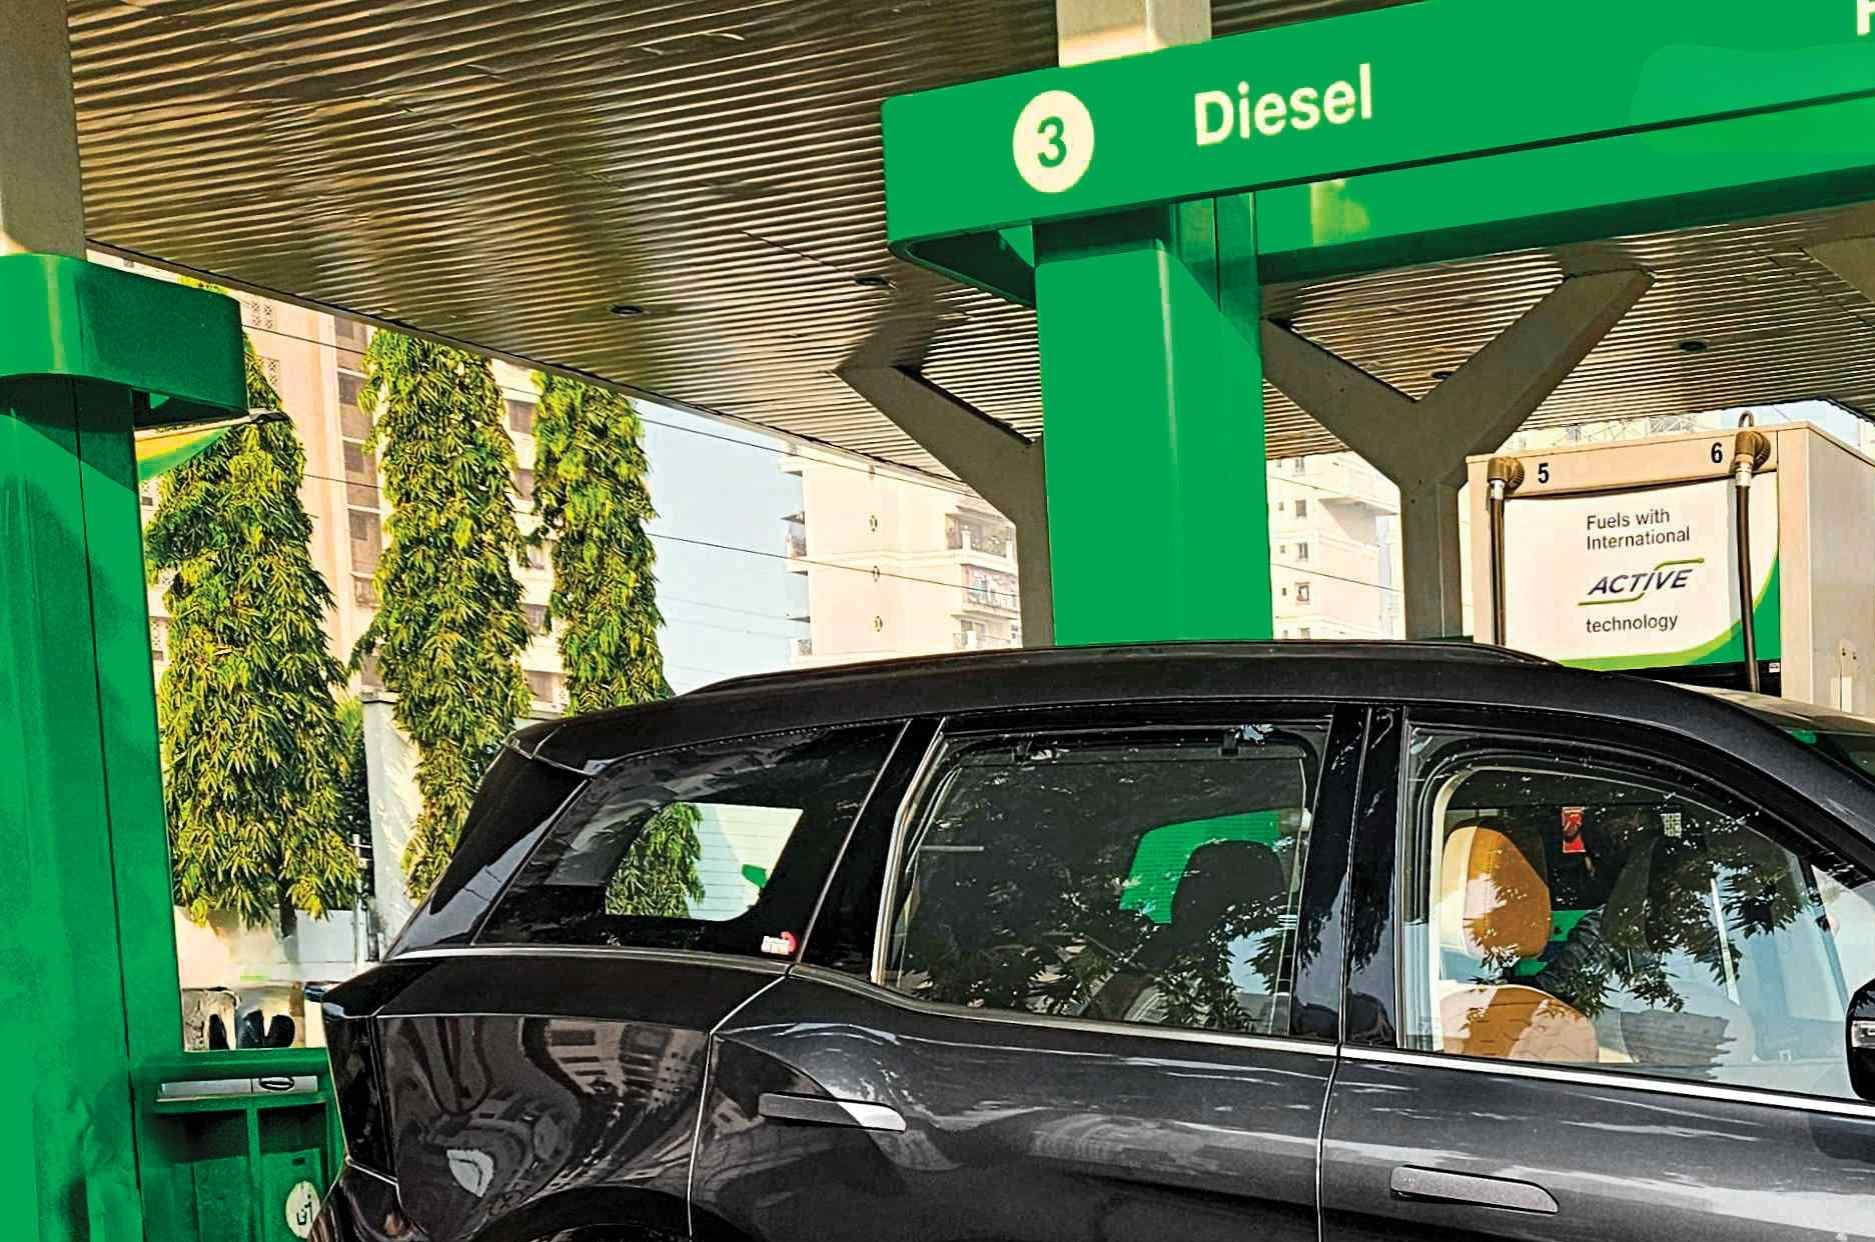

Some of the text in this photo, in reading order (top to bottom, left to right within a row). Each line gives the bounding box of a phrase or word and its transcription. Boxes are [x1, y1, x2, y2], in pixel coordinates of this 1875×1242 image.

[1194, 63, 1372, 147] Diesel
[1037, 116, 1067, 168] 3
[1711, 442, 1723, 463] 6
[1537, 462, 1549, 484] 5
[1586, 508, 1670, 530] Fuels with
[1586, 526, 1690, 550] International
[1587, 568, 1693, 596] ACTIVE
[1586, 614, 1678, 633] technology
